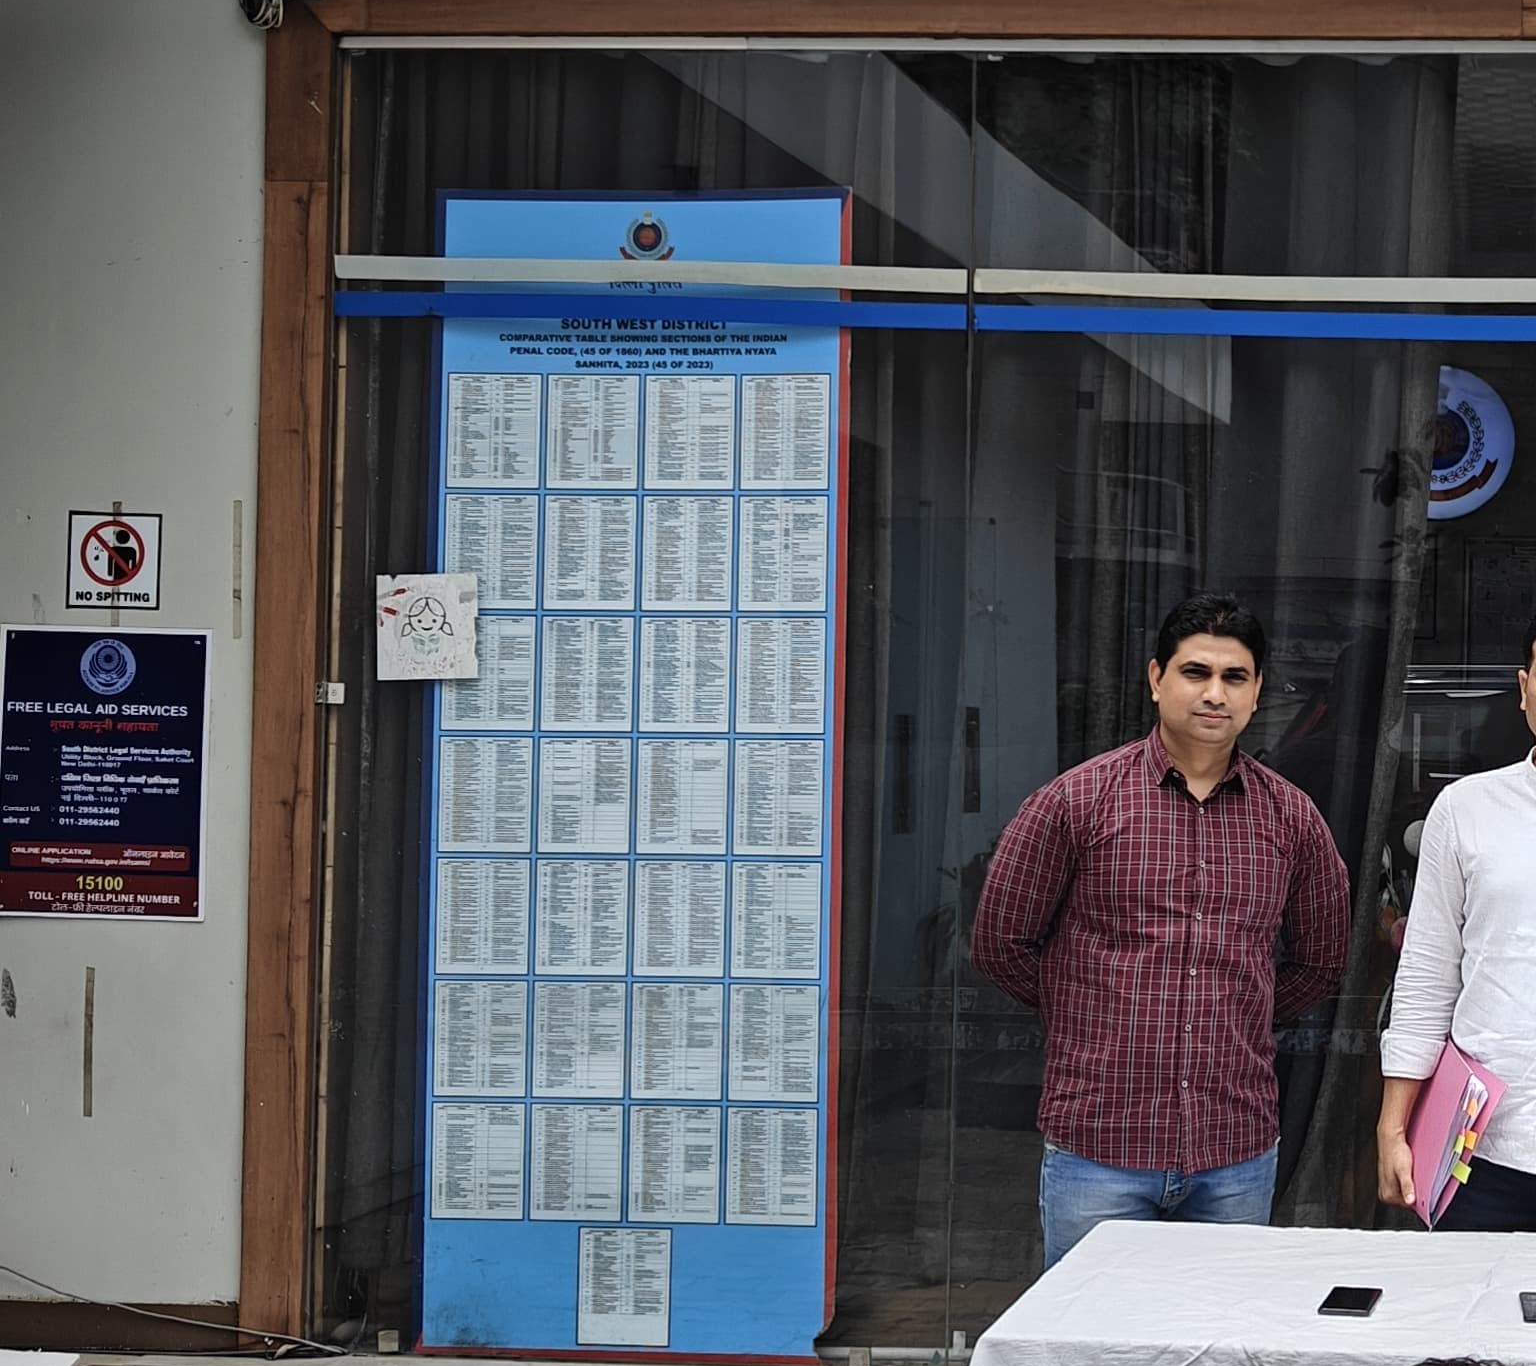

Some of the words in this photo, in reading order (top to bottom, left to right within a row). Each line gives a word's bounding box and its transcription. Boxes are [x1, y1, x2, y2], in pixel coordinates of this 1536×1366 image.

[561, 318, 612, 330] SOUTH
[617, 319, 656, 330] WEST
[499, 333, 572, 343] COMPARATIVE
[575, 334, 607, 343] TABLE
[610, 334, 658, 343] SHOWING
[661, 334, 711, 343] SECTIONS
[714, 335, 727, 343] OF
[730, 335, 750, 343] THE
[753, 334, 788, 343] INDIAN
[510, 347, 544, 355] PENAL
[546, 347, 577, 356] CODE,
[580, 347, 596, 357] (45
[599, 347, 612, 355] OF
[615, 347, 642, 357] 1860)
[645, 347, 666, 356] AND
[669, 347, 689, 356] THE
[692, 347, 743, 356] BHARTIYA
[745, 347, 777, 356] NYAYA
[575, 360, 623, 370] SANHITA,
[625, 360, 649, 369] 2023
[652, 361, 667, 370] (45
[670, 361, 683, 369] OF
[686, 361, 714, 370] 2023)
[75, 591, 92, 602] NO
[96, 591, 150, 602] SPITTING
[7, 701, 43, 713] FREE
[47, 702, 92, 714] LEGAL
[95, 704, 118, 715] AID
[121, 704, 188, 717] SERVICES
[109, 746, 128, 755] Legal
[41, 847, 92, 855] APPLICATION
[76, 875, 123, 891] 15100
[28, 891, 53, 901] TOLL
[61, 892, 85, 902] FREE
[87, 892, 134, 903] HELPLINE
[137, 894, 181, 905] NUMBER
